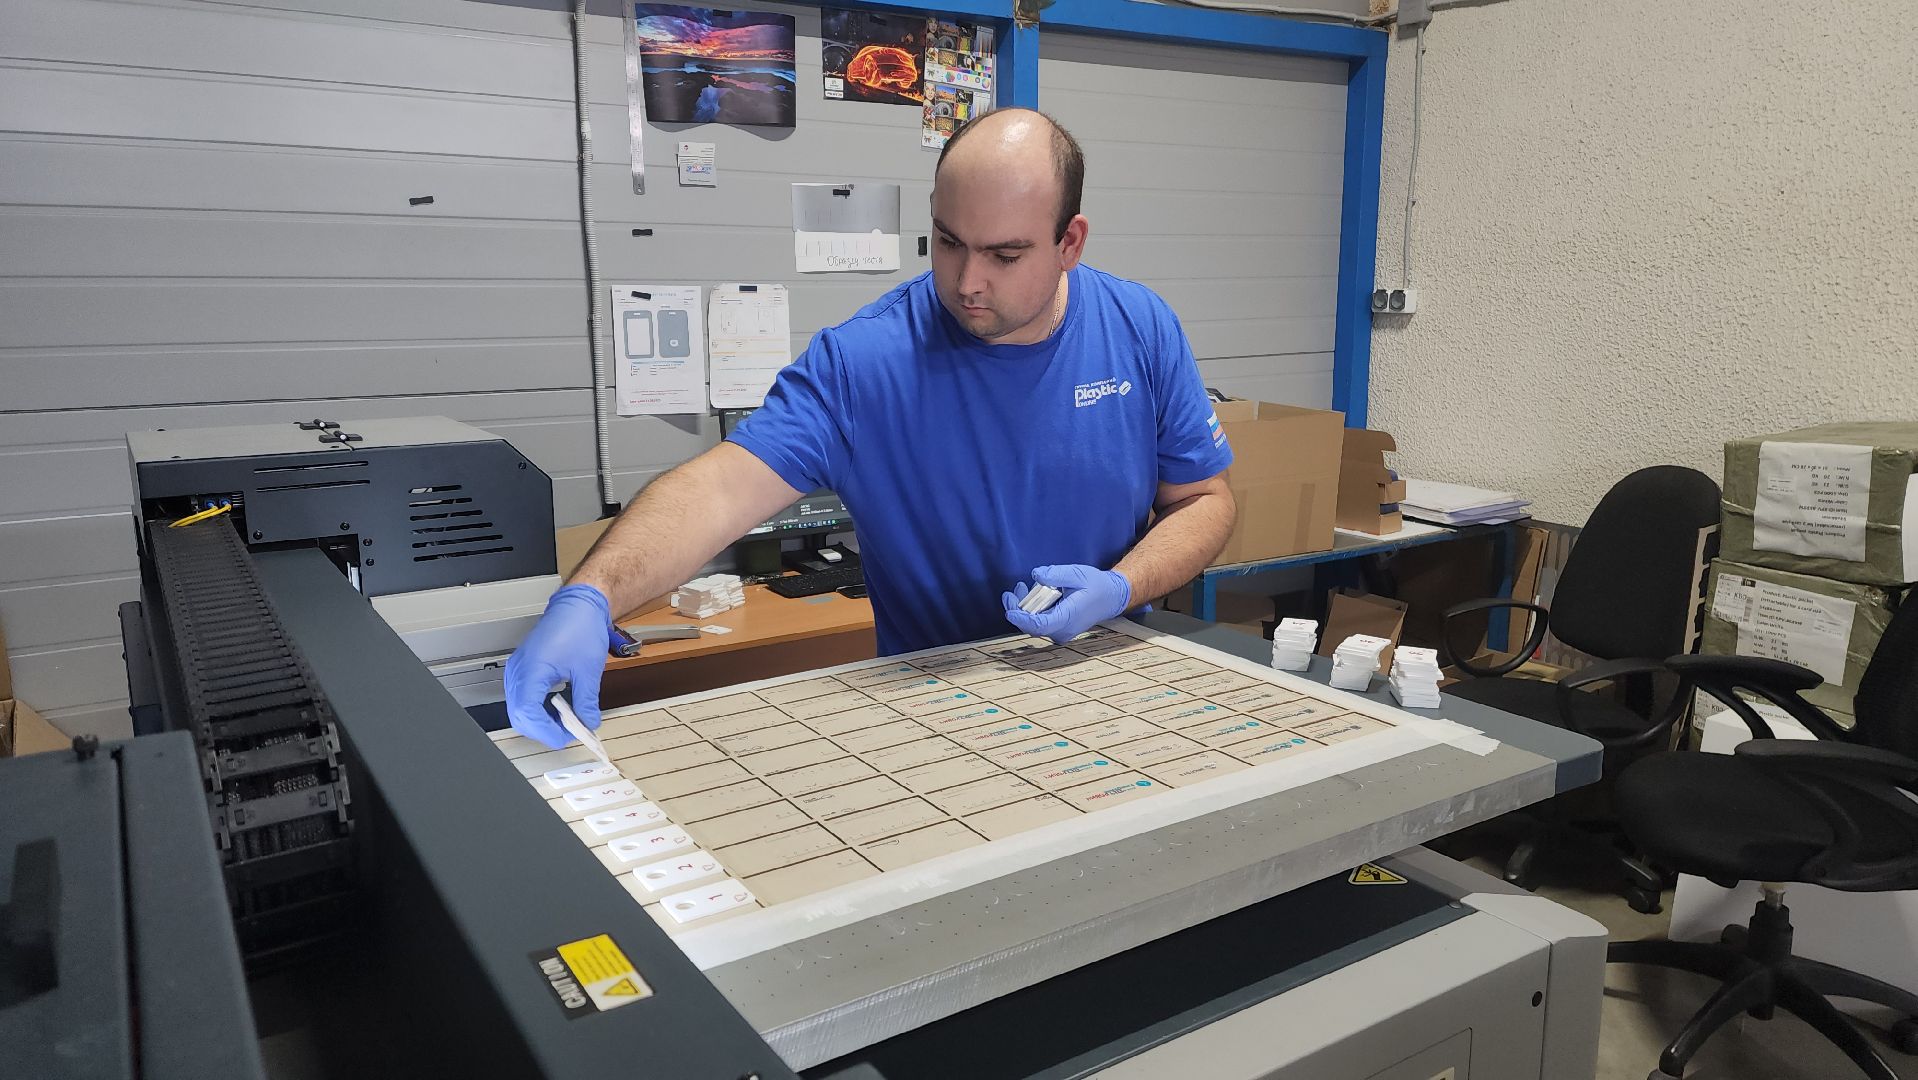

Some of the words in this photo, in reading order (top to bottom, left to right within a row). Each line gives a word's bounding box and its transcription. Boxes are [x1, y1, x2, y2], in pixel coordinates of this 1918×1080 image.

[677, 863, 693, 871] 2
[708, 893, 723, 901] 1
[538, 956, 587, 1009] CAUTION
